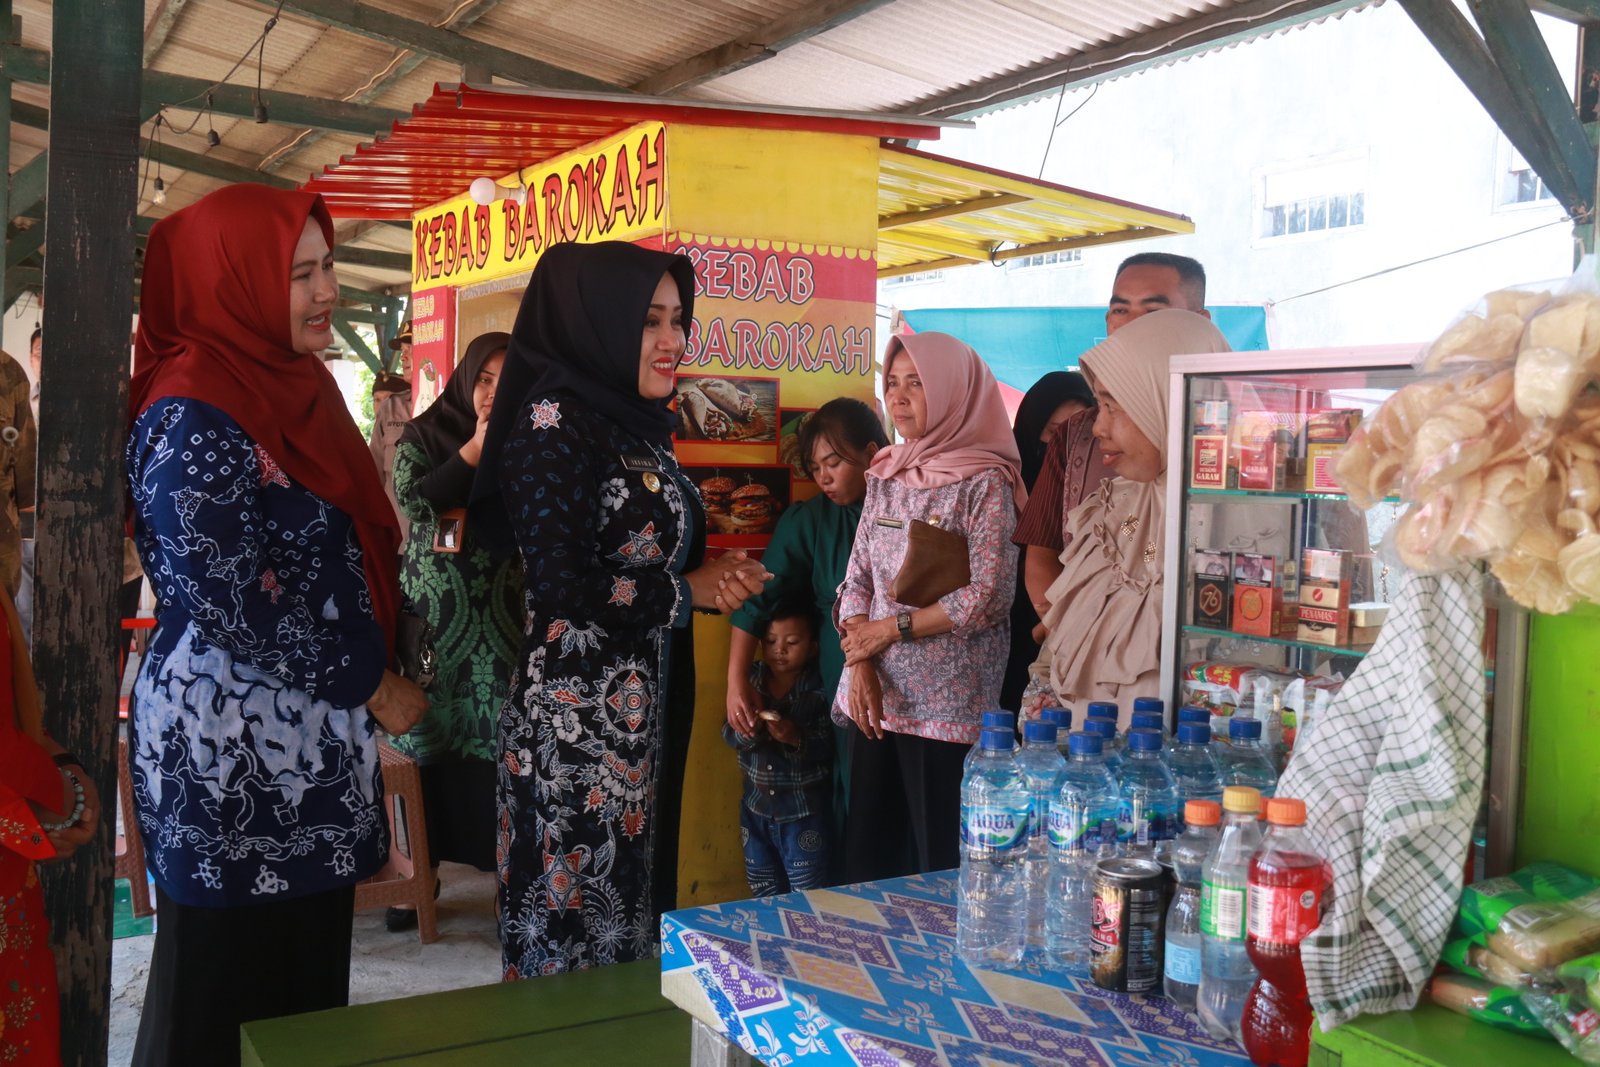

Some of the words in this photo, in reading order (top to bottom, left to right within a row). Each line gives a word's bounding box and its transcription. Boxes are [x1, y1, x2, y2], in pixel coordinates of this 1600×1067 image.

[415, 204, 491, 285] KEBAB
[502, 127, 665, 262] BAROKAH
[678, 317, 871, 375] BAROKAH
[1196, 472, 1220, 481] GARAM
[971, 812, 1015, 832] AQUA
[1050, 810, 1072, 830] QUA
